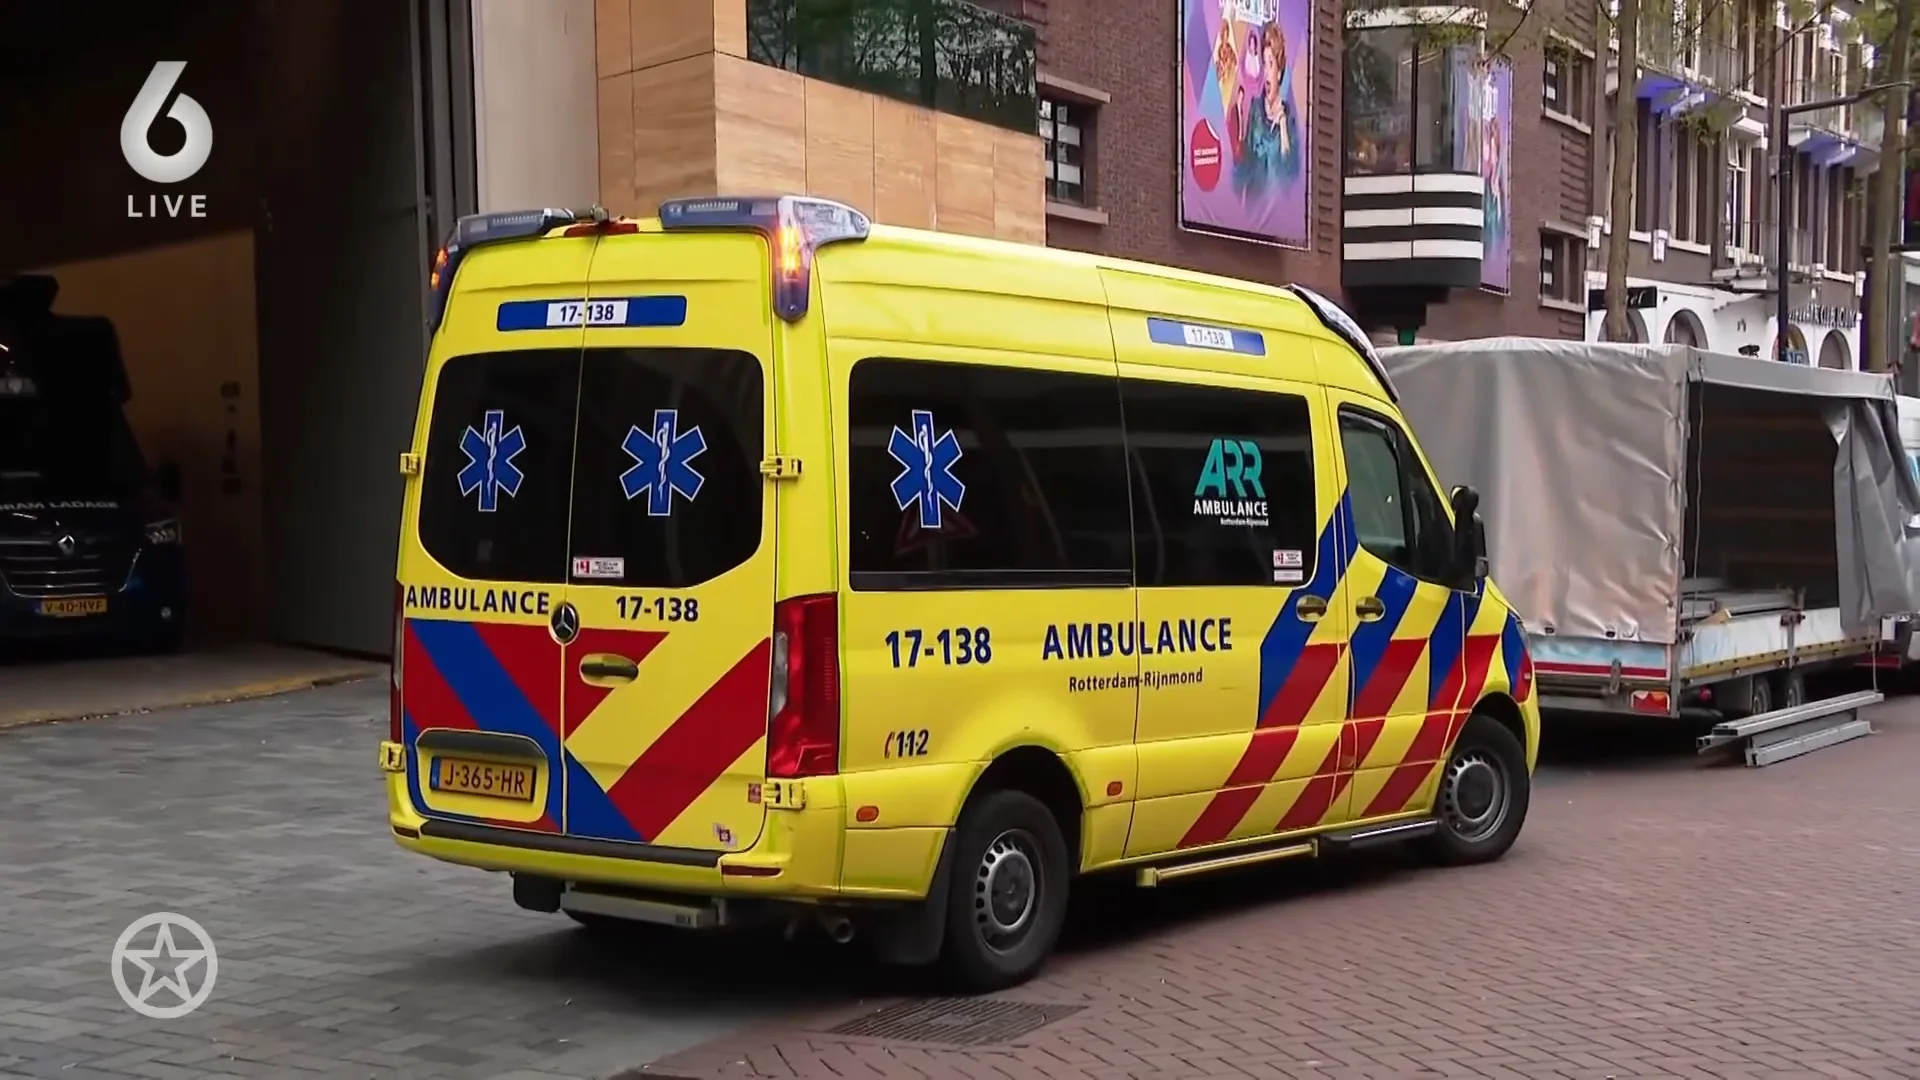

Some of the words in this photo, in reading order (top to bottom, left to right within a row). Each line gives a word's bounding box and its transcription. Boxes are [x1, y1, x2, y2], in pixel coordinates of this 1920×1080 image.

[559, 303, 615, 323] 17-138
[1191, 328, 1226, 345] 17-138
[1194, 438, 1266, 498] ARR
[1193, 499, 1269, 517] AMBULANCE
[405, 585, 550, 615] AMBULANCE
[616, 595, 699, 622] 17-138
[885, 627, 991, 668] 17-138
[1042, 617, 1233, 661] AMBULANCE
[1069, 667, 1203, 693] Rotterdam-Rijnmond
[444, 763, 525, 795] J-365-HR
